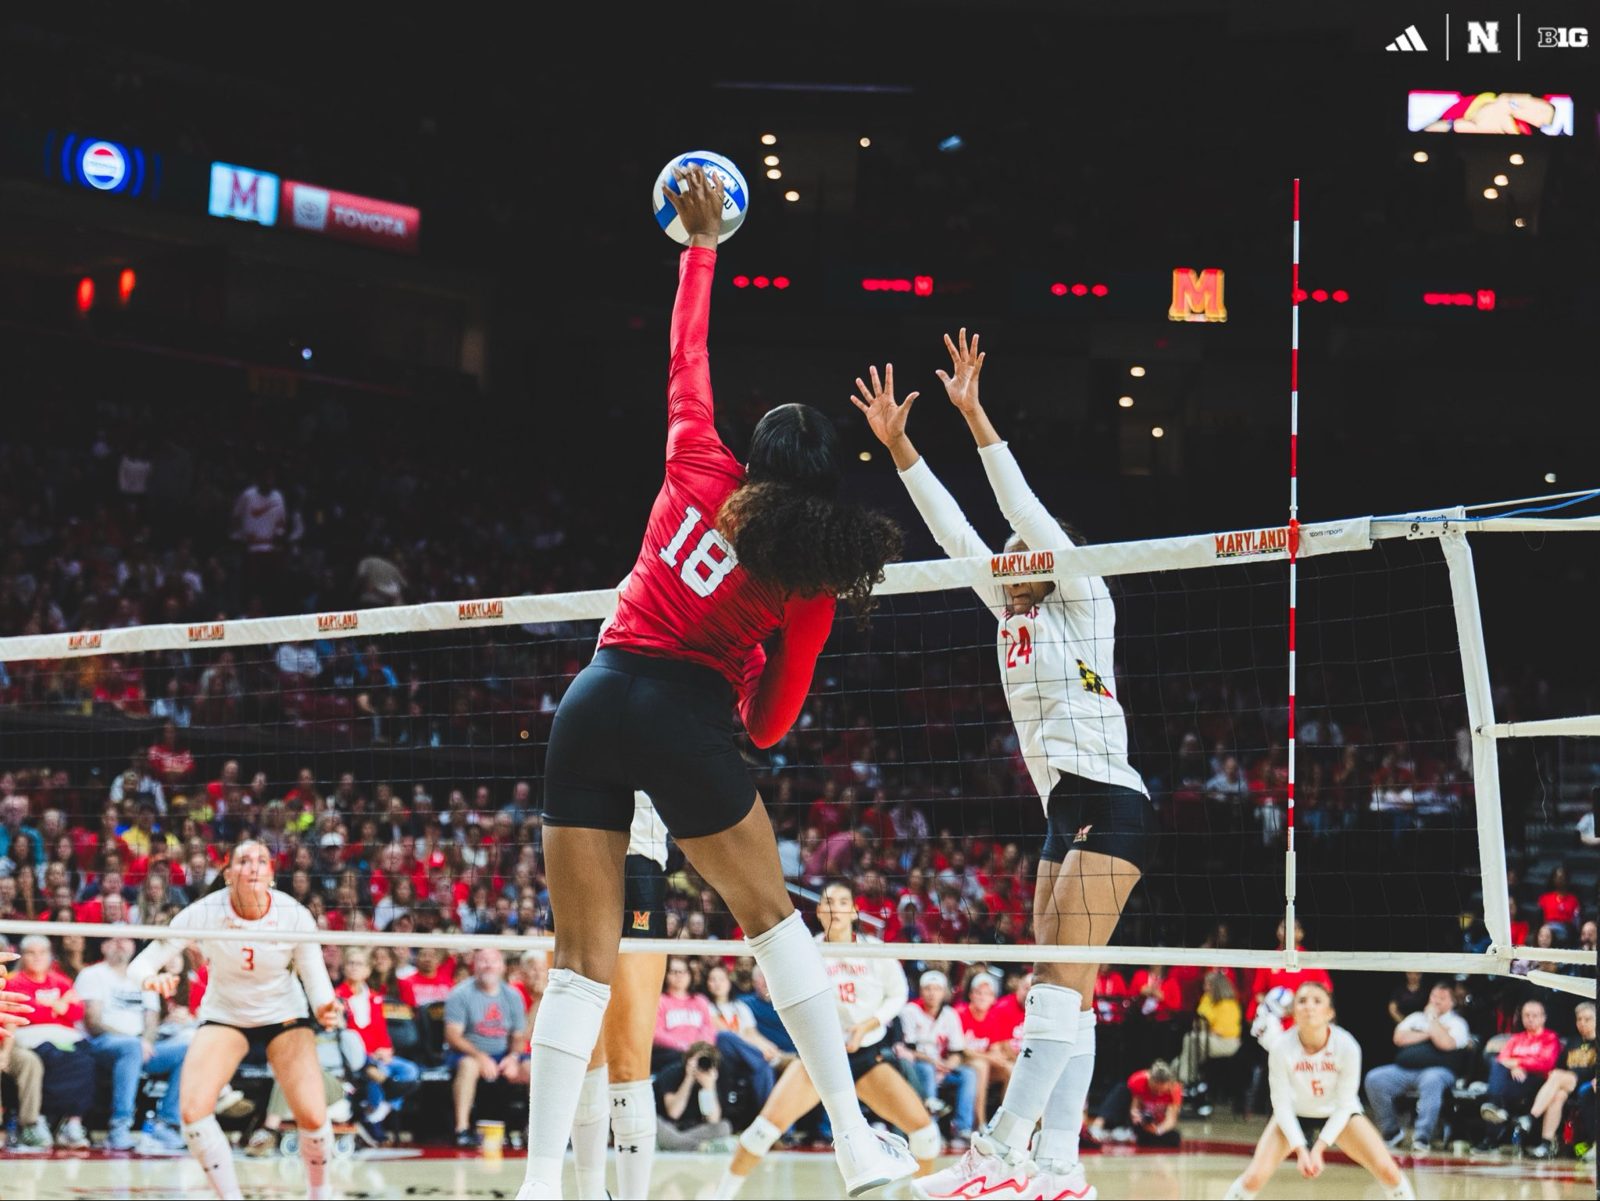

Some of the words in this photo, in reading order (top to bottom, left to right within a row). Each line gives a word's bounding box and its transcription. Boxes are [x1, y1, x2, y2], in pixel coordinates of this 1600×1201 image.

[332, 205, 407, 236] TOYOTA
[1168, 268, 1227, 323] M
[659, 505, 740, 598] 18
[1215, 528, 1287, 553] MARYLAND
[991, 551, 1055, 573] MARYLAND
[317, 613, 358, 628] MARYLAND
[458, 601, 503, 617] MARYLAND
[1001, 626, 1032, 669] 24
[242, 947, 254, 971] 3
[838, 982, 857, 1003] 18
